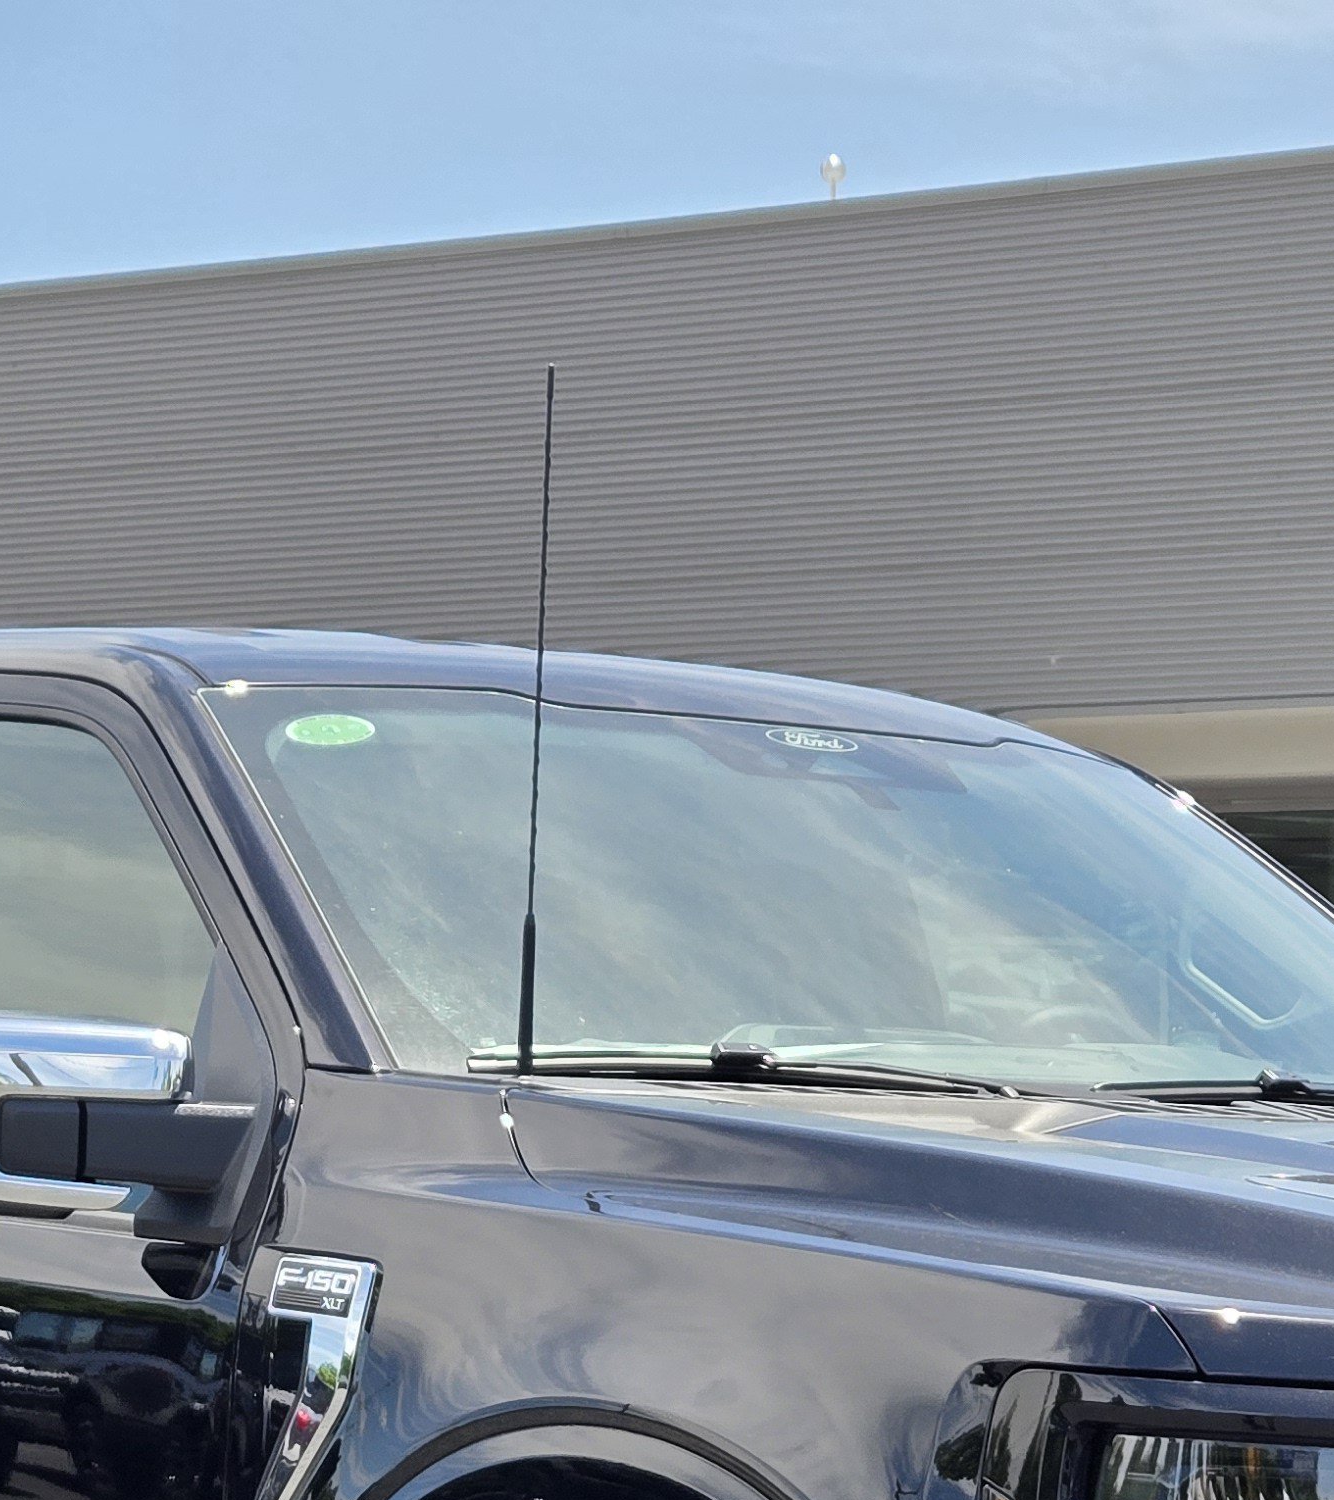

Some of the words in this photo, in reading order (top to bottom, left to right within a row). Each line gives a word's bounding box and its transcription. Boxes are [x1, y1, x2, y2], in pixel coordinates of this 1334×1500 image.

[783, 730, 844, 749] Ford
[277, 1266, 357, 1295] F-150
[320, 1296, 346, 1311] XLT
